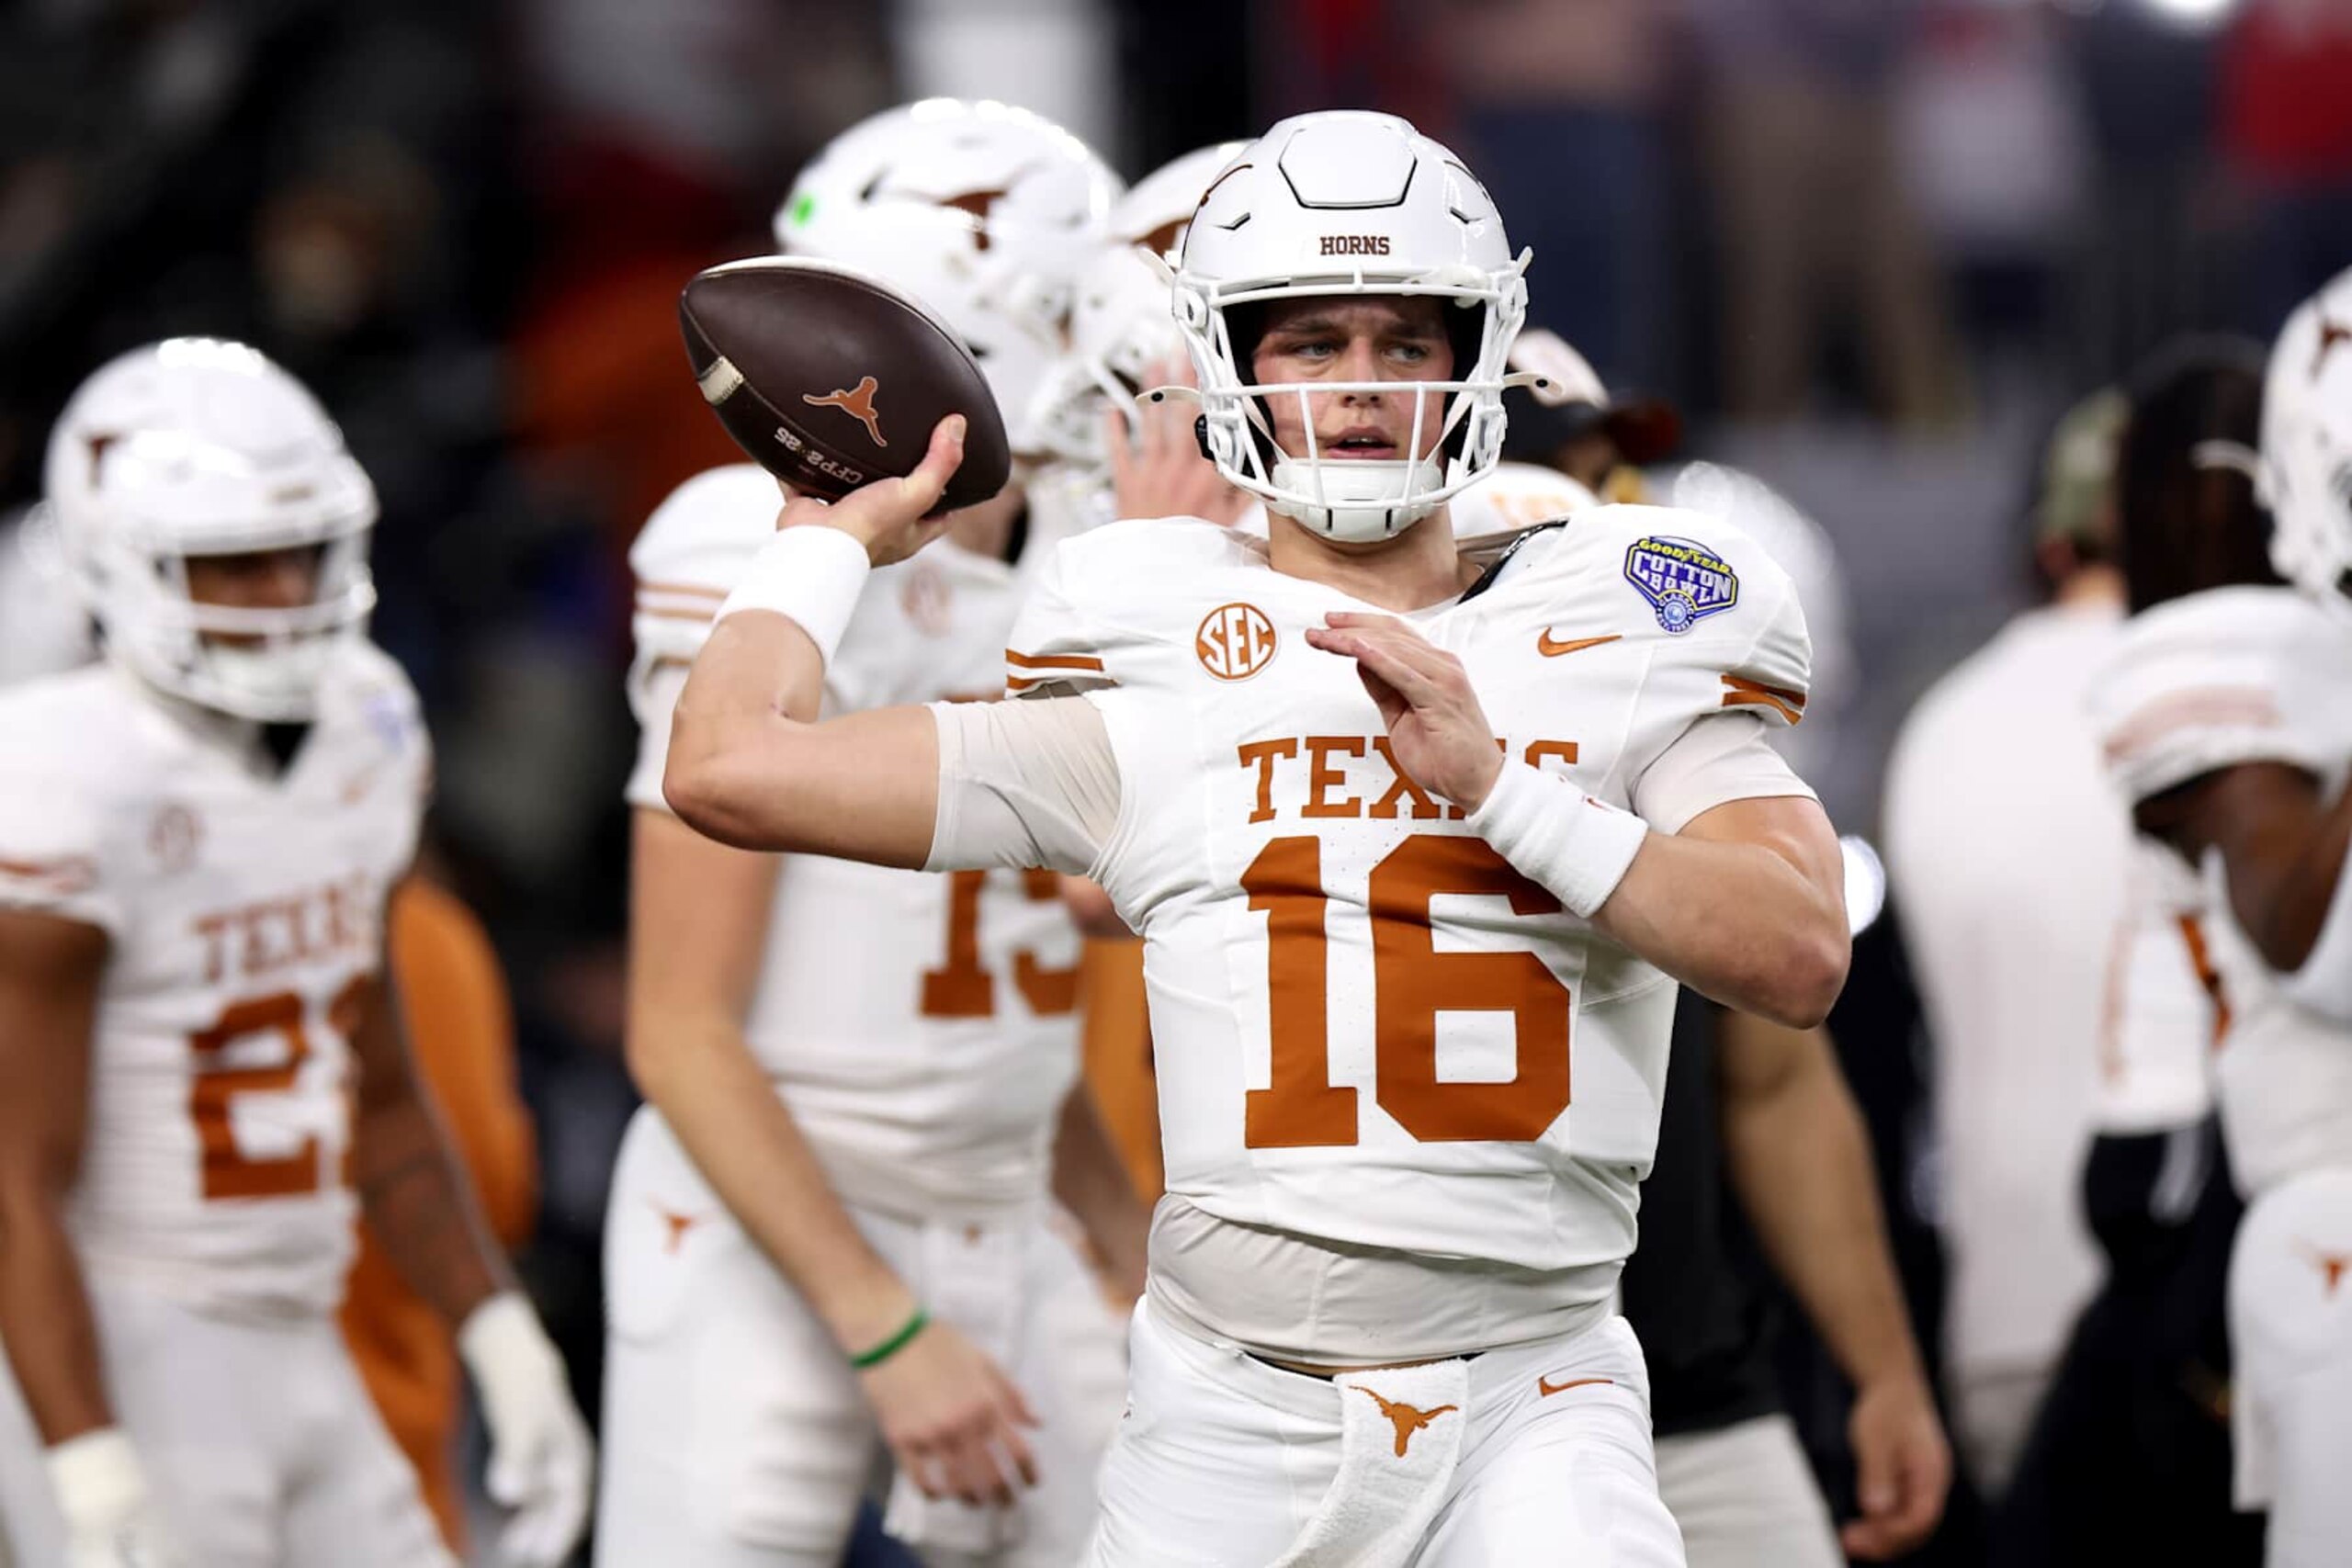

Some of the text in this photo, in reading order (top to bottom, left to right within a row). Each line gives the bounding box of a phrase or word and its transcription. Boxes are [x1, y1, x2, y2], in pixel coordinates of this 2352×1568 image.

[1320, 235, 1390, 255] HORNS
[1633, 550, 1733, 601] COTTON
[1638, 539, 1730, 574] GOODYEAR
[1649, 572, 1710, 604] BOWL
[1200, 606, 1272, 675] SEC
[1238, 736, 1578, 824] TEX
[1239, 834, 1571, 1148] 16
